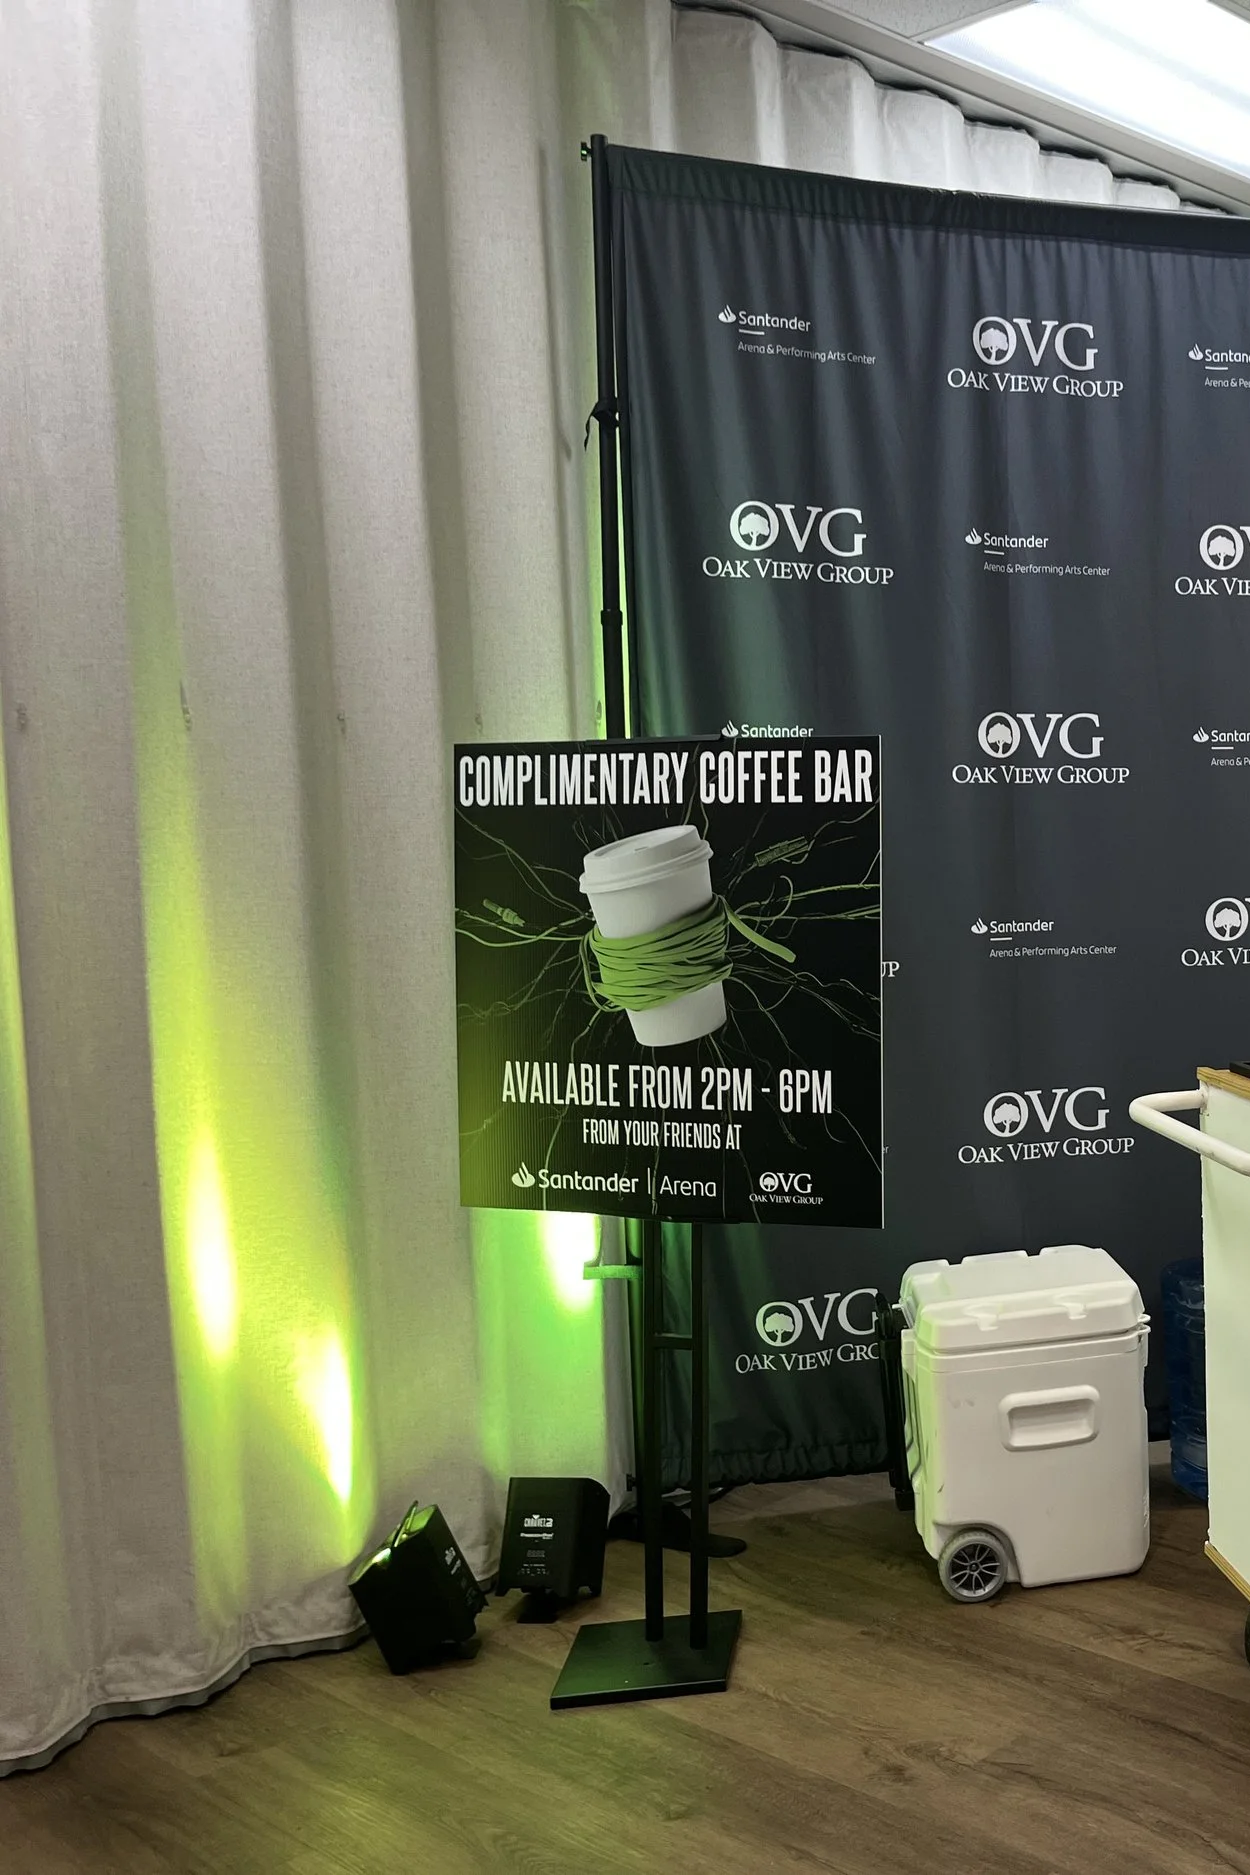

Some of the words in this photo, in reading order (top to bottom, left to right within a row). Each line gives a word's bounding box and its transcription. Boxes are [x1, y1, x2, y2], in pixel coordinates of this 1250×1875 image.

[738, 309, 810, 332] Santander
[738, 341, 765, 355] Arena
[767, 344, 774, 355] &
[776, 346, 826, 362] Performing
[827, 348, 846, 362] Arts
[847, 351, 876, 365] Center
[972, 316, 1098, 371] OVG
[947, 367, 990, 391] OAK
[993, 372, 1050, 396] VIEW
[1052, 375, 1124, 398] GROUP
[1205, 378, 1229, 388] Arena
[1230, 379, 1238, 388] &
[730, 500, 866, 558] OVG
[984, 532, 1048, 550] Santander
[702, 556, 747, 579] OAK
[754, 558, 816, 582] VIEW
[817, 562, 894, 585] GROUP
[984, 562, 1004, 573] Arena
[1006, 564, 1014, 573] &
[1016, 564, 1063, 578] Performing
[1064, 565, 1082, 575] Arts
[1083, 566, 1110, 576] Center
[1174, 576, 1218, 596] OAK
[741, 724, 813, 738] Santander
[978, 712, 1104, 759] OVG
[1210, 756, 1234, 766] Arena
[1236, 757, 1242, 766] &
[460, 752, 689, 808] COMPLIMENTARY
[700, 750, 802, 804] COFFEE
[815, 749, 872, 804] BAR
[952, 764, 998, 784] OAK
[1000, 766, 1054, 784] VIEW
[1057, 766, 1130, 784] GROUP
[990, 918, 1054, 934] Santander
[990, 947, 1012, 958] Arena
[1014, 947, 1021, 957] &
[1022, 946, 1070, 959] Performing
[1070, 945, 1088, 955] Arts
[1089, 944, 1116, 956] Center
[1181, 949, 1224, 967] OAK
[502, 1061, 620, 1107] AVAILABLE
[628, 1064, 692, 1110] FROM
[701, 1068, 752, 1112] 2PM
[778, 1070, 832, 1114] 6PM
[984, 1086, 1110, 1138] OVG
[583, 1119, 620, 1144] FROM
[623, 1120, 660, 1147] YOUR
[664, 1123, 721, 1149] FRIENDS
[726, 1125, 742, 1150] AT
[958, 1144, 1004, 1164] OAK
[1006, 1141, 1060, 1162] VIEW
[1062, 1136, 1134, 1156] GROUP
[538, 1168, 638, 1194] Santander
[660, 1176, 717, 1198] Arena
[759, 1172, 812, 1194] OVG
[749, 1193, 768, 1204] OAK
[769, 1194, 792, 1204] VIEW
[792, 1194, 824, 1205] GROUP
[756, 1288, 878, 1347] OVG
[736, 1354, 776, 1374] OAK
[782, 1348, 834, 1372] VIEW
[836, 1343, 878, 1363] GRO
